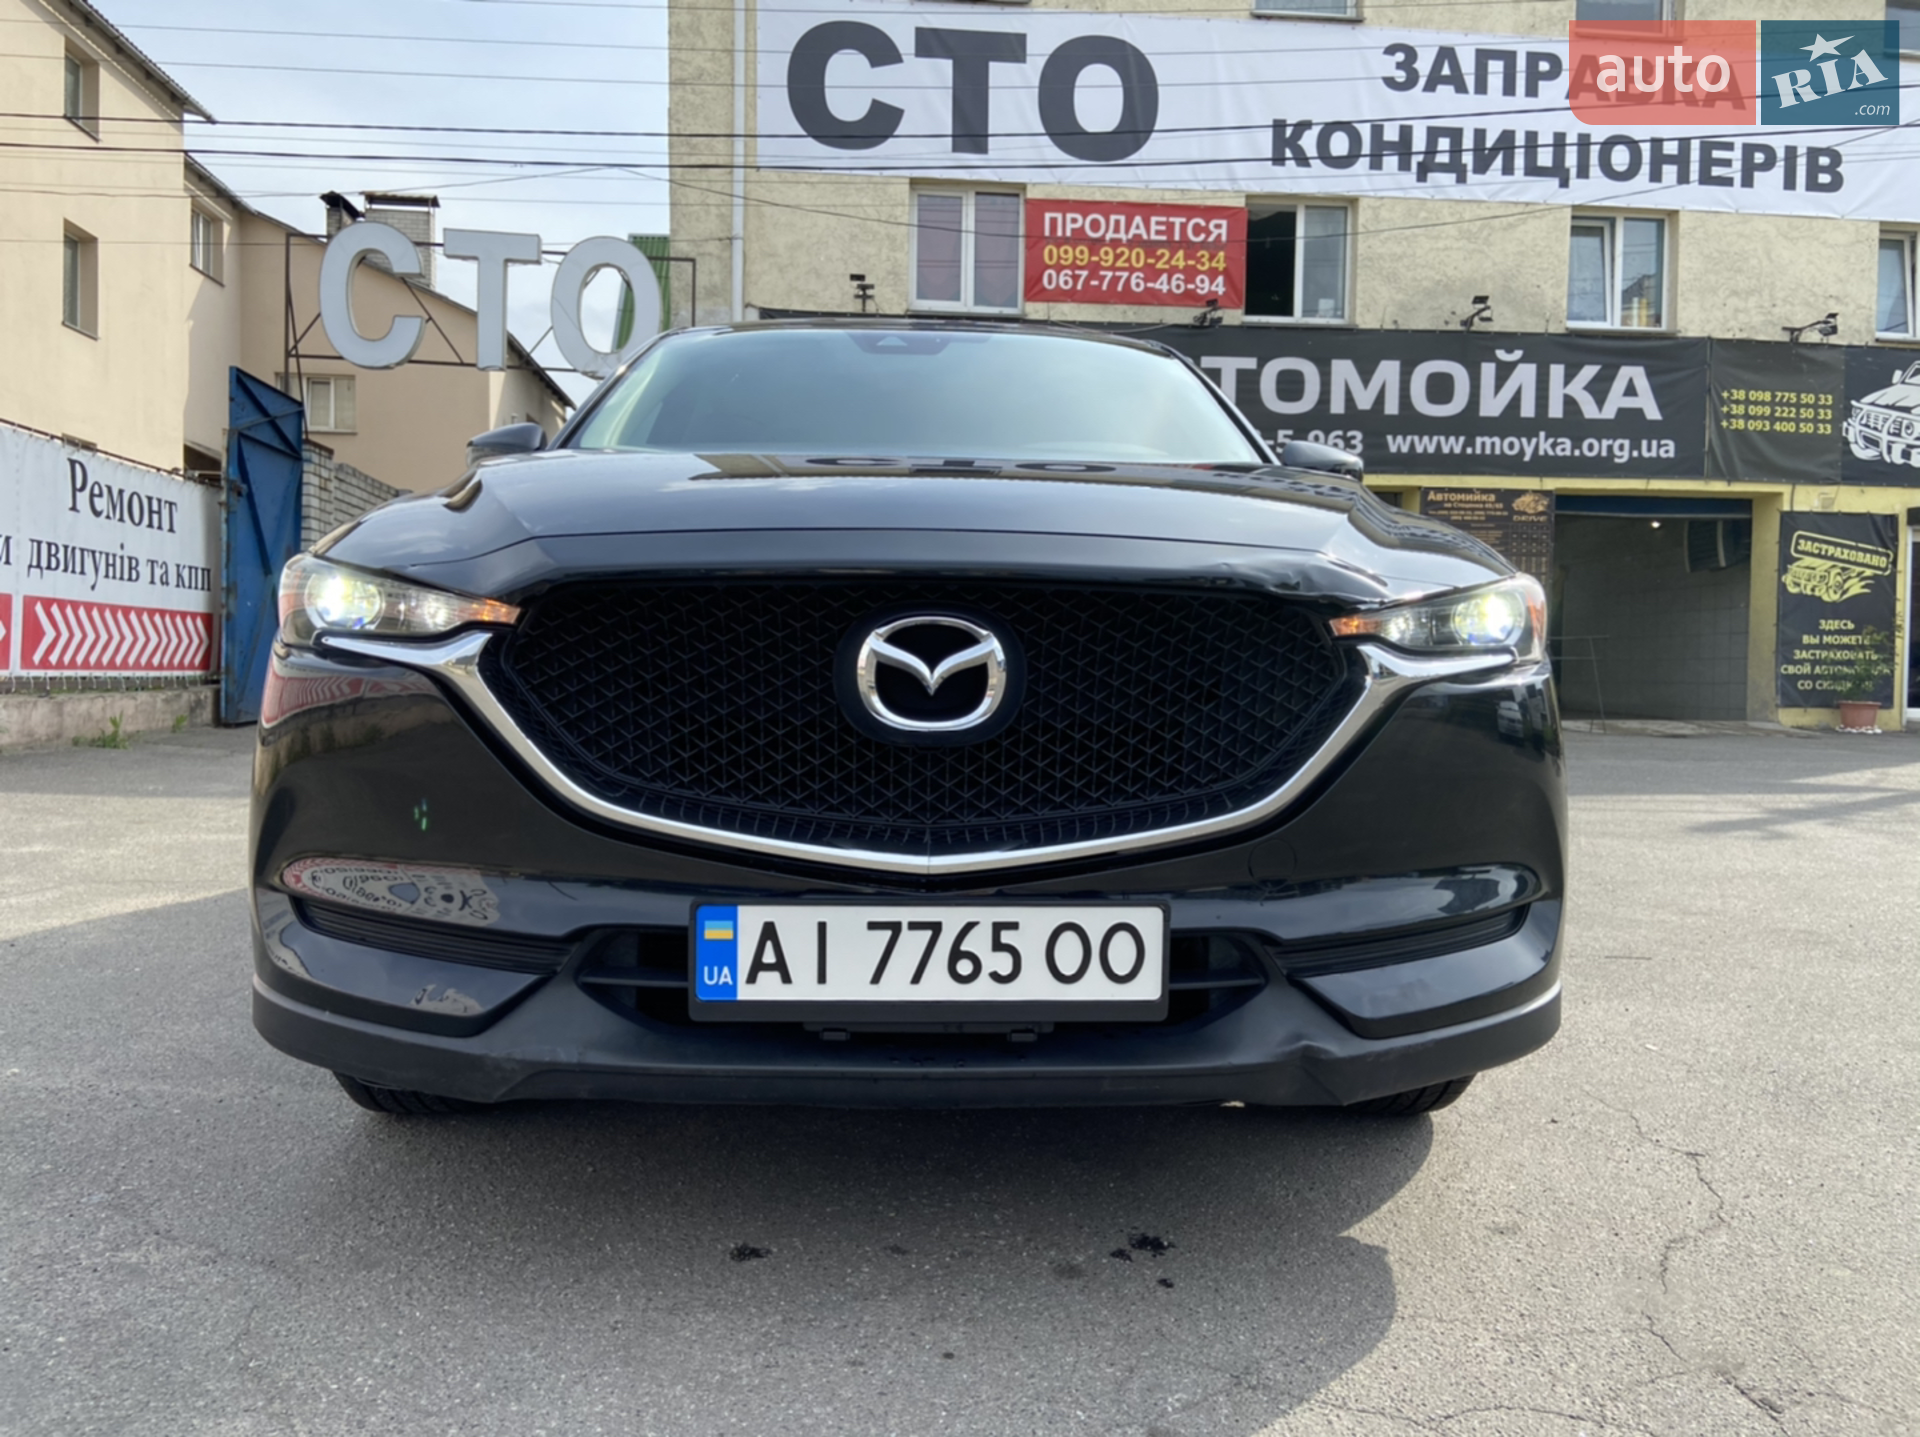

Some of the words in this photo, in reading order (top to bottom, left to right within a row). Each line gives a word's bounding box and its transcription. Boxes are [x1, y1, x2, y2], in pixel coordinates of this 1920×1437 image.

[787, 20, 1159, 162] СТО
[1271, 119, 1845, 193] КОНДИЦІОНЕРІВ
[1044, 212, 1228, 243] ПРОДАЕТСЯ
[1043, 245, 1227, 271] 099-920-24-34
[1042, 269, 1226, 295] 067-776-46-94
[319, 221, 663, 380] СТО
[1184, 351, 1662, 421] ТОМОЙКА
[1722, 389, 1746, 401] +38
[1748, 390, 1772, 402] 098
[1774, 391, 1797, 403] 775
[1800, 393, 1815, 404] 50
[1818, 394, 1833, 405] 33
[1721, 404, 1745, 415] +38
[1748, 405, 1771, 416] 099
[1774, 406, 1797, 418] 222
[1800, 408, 1815, 419] 50
[1817, 409, 1832, 420] 33
[1721, 418, 1745, 430] +38
[1747, 420, 1770, 432] 093
[1773, 421, 1796, 432] 400
[1799, 422, 1814, 434] 50
[1817, 423, 1832, 435] 33
[1386, 431, 1676, 463] www.moyka.org.ua
[67, 457, 178, 534] Ремонт
[1427, 491, 1496, 502] Автомийка
[27, 537, 140, 591] двигунів
[146, 558, 170, 587] та
[174, 563, 212, 592] кпп
[1797, 539, 1888, 568] ЗАСТРАХОВАНО
[1818, 619, 1855, 631] ЗДЕСЬ
[1802, 634, 1820, 645] ВЫ
[1780, 662, 1812, 675] СВОЙ
[1797, 680, 1813, 690] СО
[867, 921, 1023, 984] 7765
[704, 965, 733, 985] UA
